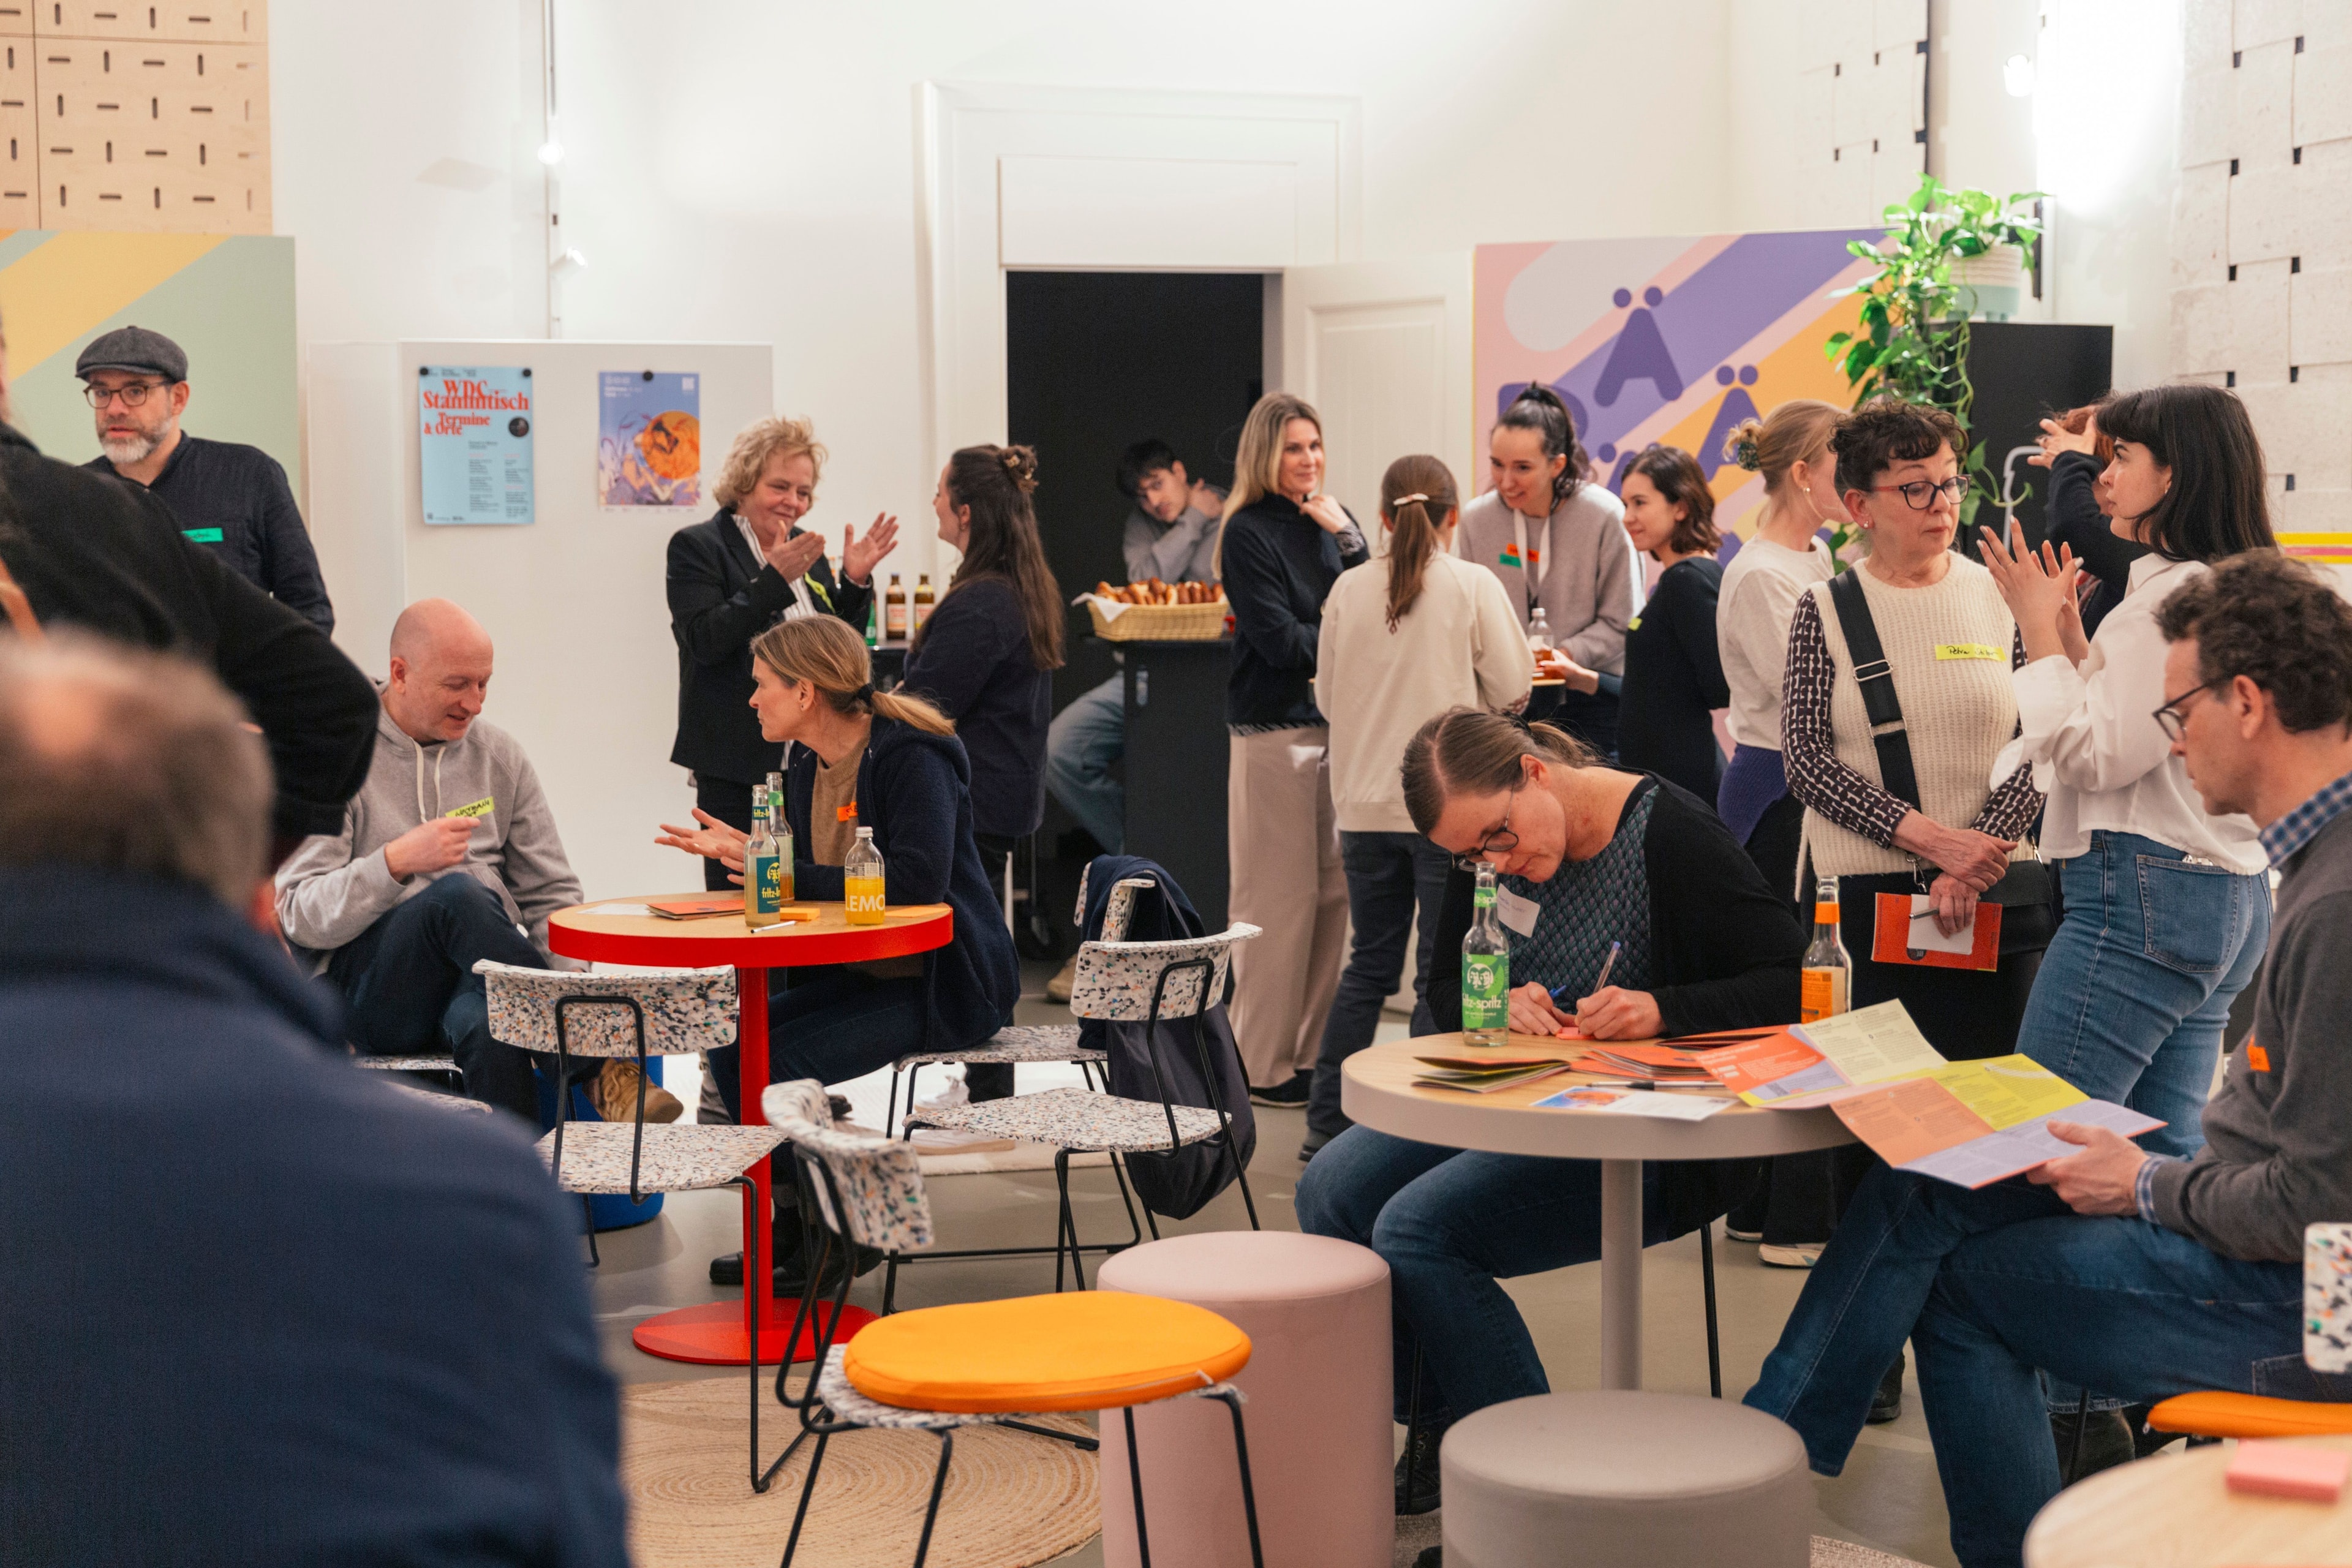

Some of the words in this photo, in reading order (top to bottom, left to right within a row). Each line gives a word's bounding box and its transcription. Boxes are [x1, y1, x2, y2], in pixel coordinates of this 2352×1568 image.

[443, 380, 488, 398] WDC
[423, 390, 529, 410] Stammtisch
[438, 412, 489, 426] Termine
[435, 421, 462, 435] Orte
[845, 894, 885, 911] LEMO
